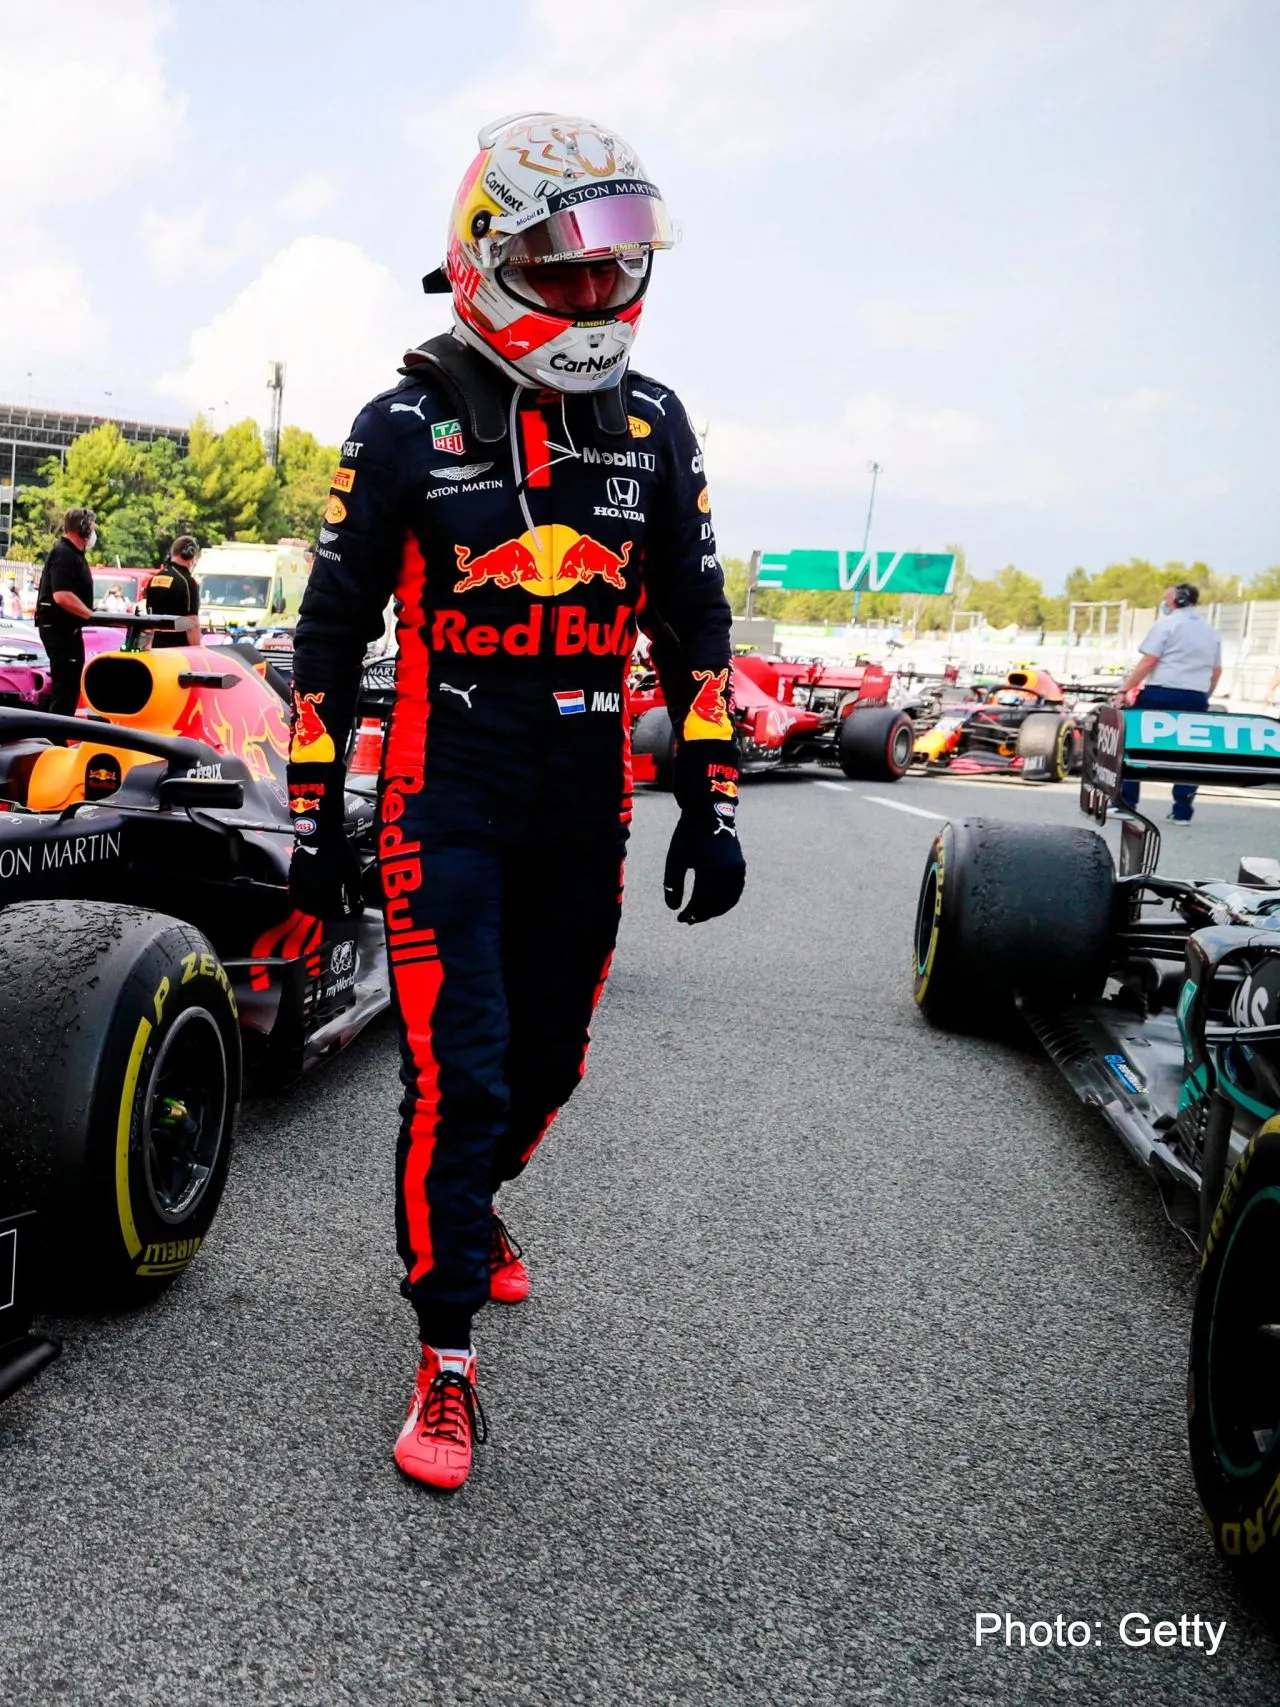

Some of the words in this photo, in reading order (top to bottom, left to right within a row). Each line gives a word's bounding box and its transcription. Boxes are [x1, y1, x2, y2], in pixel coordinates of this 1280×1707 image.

[485, 171, 524, 213] CarNext
[558, 185, 610, 209] ASTON
[615, 183, 661, 199] MARTIN
[516, 211, 537, 227] Mobil
[549, 349, 626, 373] CarNext
[435, 421, 463, 437] TA
[436, 434, 465, 453] HEU
[582, 446, 637, 468] Mobil
[426, 485, 459, 500] ASTON
[462, 480, 503, 493] MARTIN
[593, 506, 646, 523] HONDA
[431, 604, 544, 657] Red
[367, 667, 397, 677] MART
[591, 690, 621, 713] MAX
[1096, 721, 1121, 758] PSON
[41, 831, 121, 871] MARTIN
[180, 951, 239, 1019] ZERO
